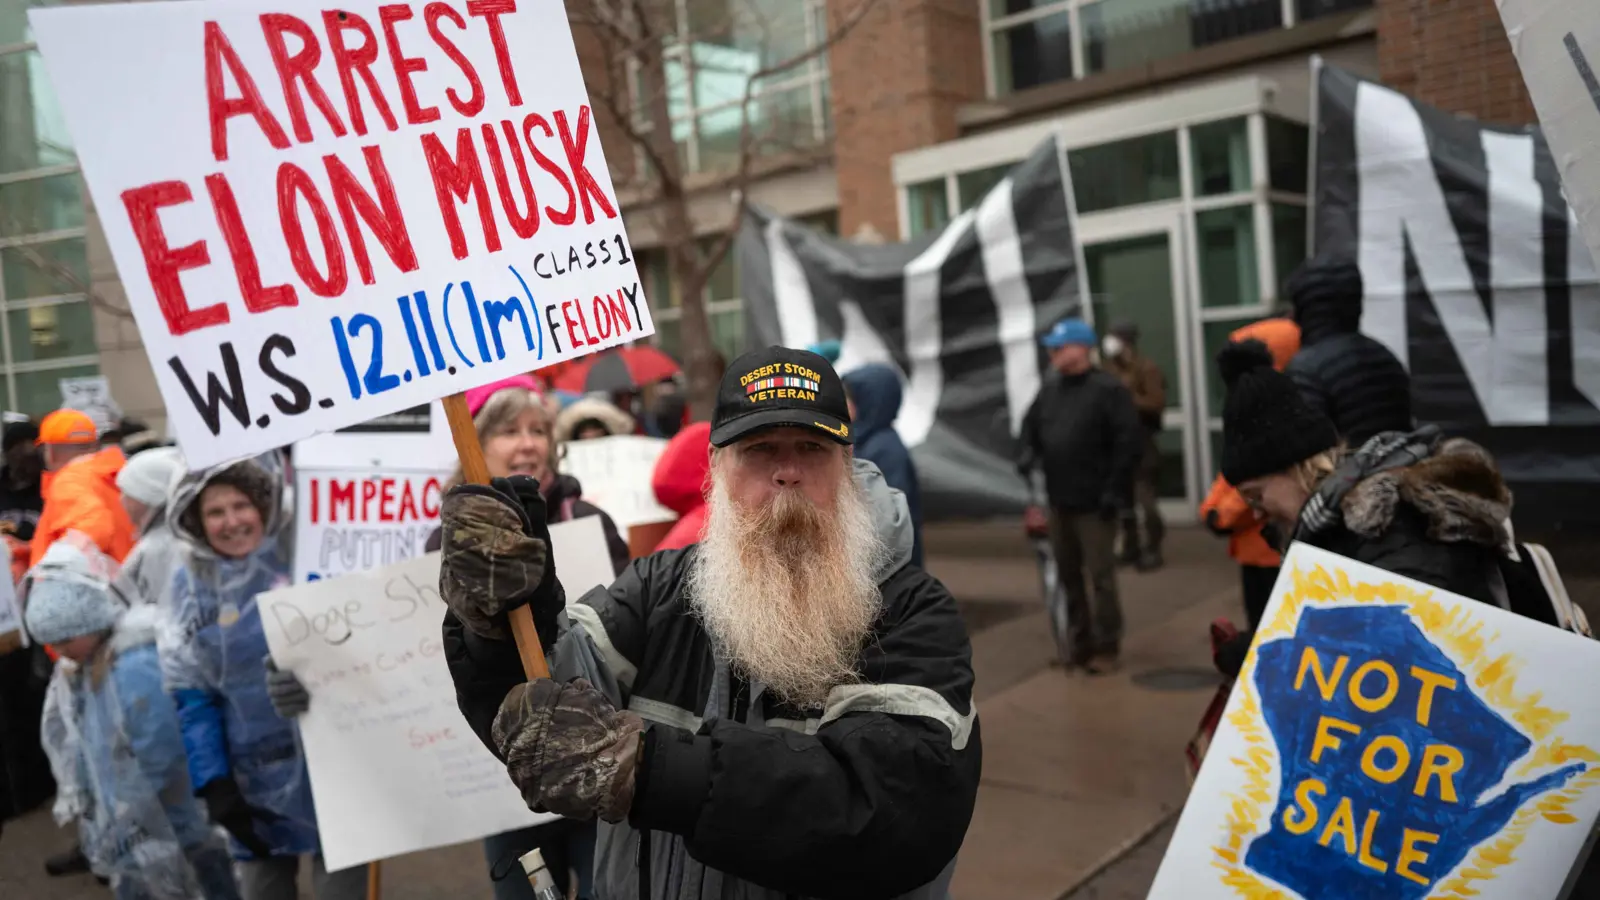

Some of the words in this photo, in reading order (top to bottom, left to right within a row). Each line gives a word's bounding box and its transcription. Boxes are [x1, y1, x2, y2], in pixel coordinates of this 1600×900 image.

[203, 0, 523, 162] ARREST
[120, 145, 419, 336] ELON
[420, 105, 617, 260] MUSK
[545, 282, 644, 354] FELONY
[168, 333, 334, 437] W.S.
[740, 363, 782, 387] DESERT
[784, 362, 821, 384] STORM
[749, 388, 816, 403] VETERAN
[310, 476, 442, 526] IMPEAC
[270, 600, 376, 647] Doge
[384, 573, 441, 622] Sh
[1293, 645, 1457, 727] NOT
[1309, 715, 1465, 803] FOR
[1282, 778, 1440, 887] SALE
